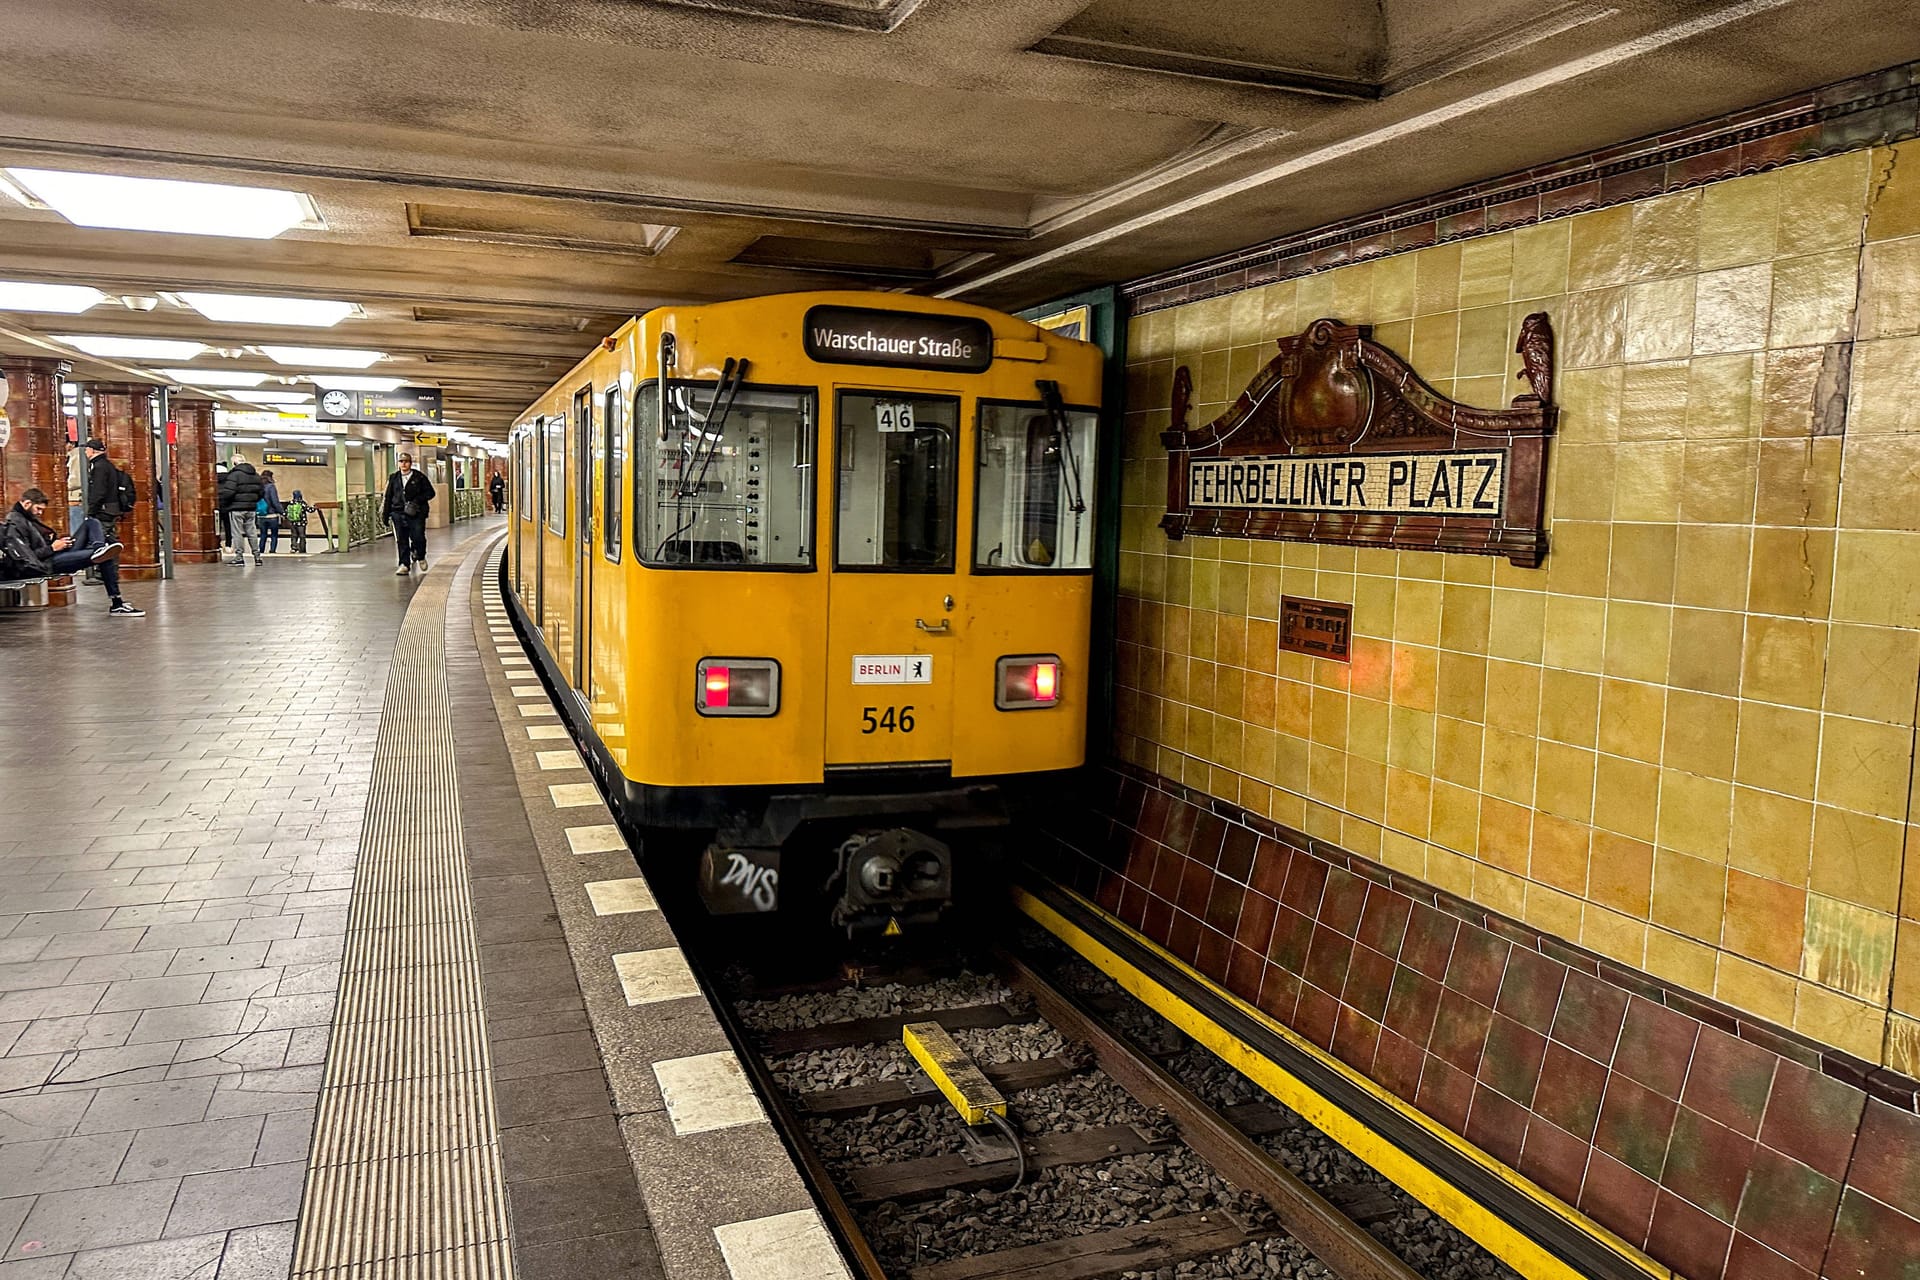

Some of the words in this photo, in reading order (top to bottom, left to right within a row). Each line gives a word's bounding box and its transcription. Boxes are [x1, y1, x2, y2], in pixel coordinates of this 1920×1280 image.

[814, 327, 916, 355] Warschauer
[918, 336, 972, 359] Straße
[880, 409, 911, 429] 46
[1191, 461, 1366, 507] FEHRBELLINER
[1387, 458, 1498, 510] PLATZ
[859, 664, 901, 675] BERLIN
[861, 705, 915, 735] 546
